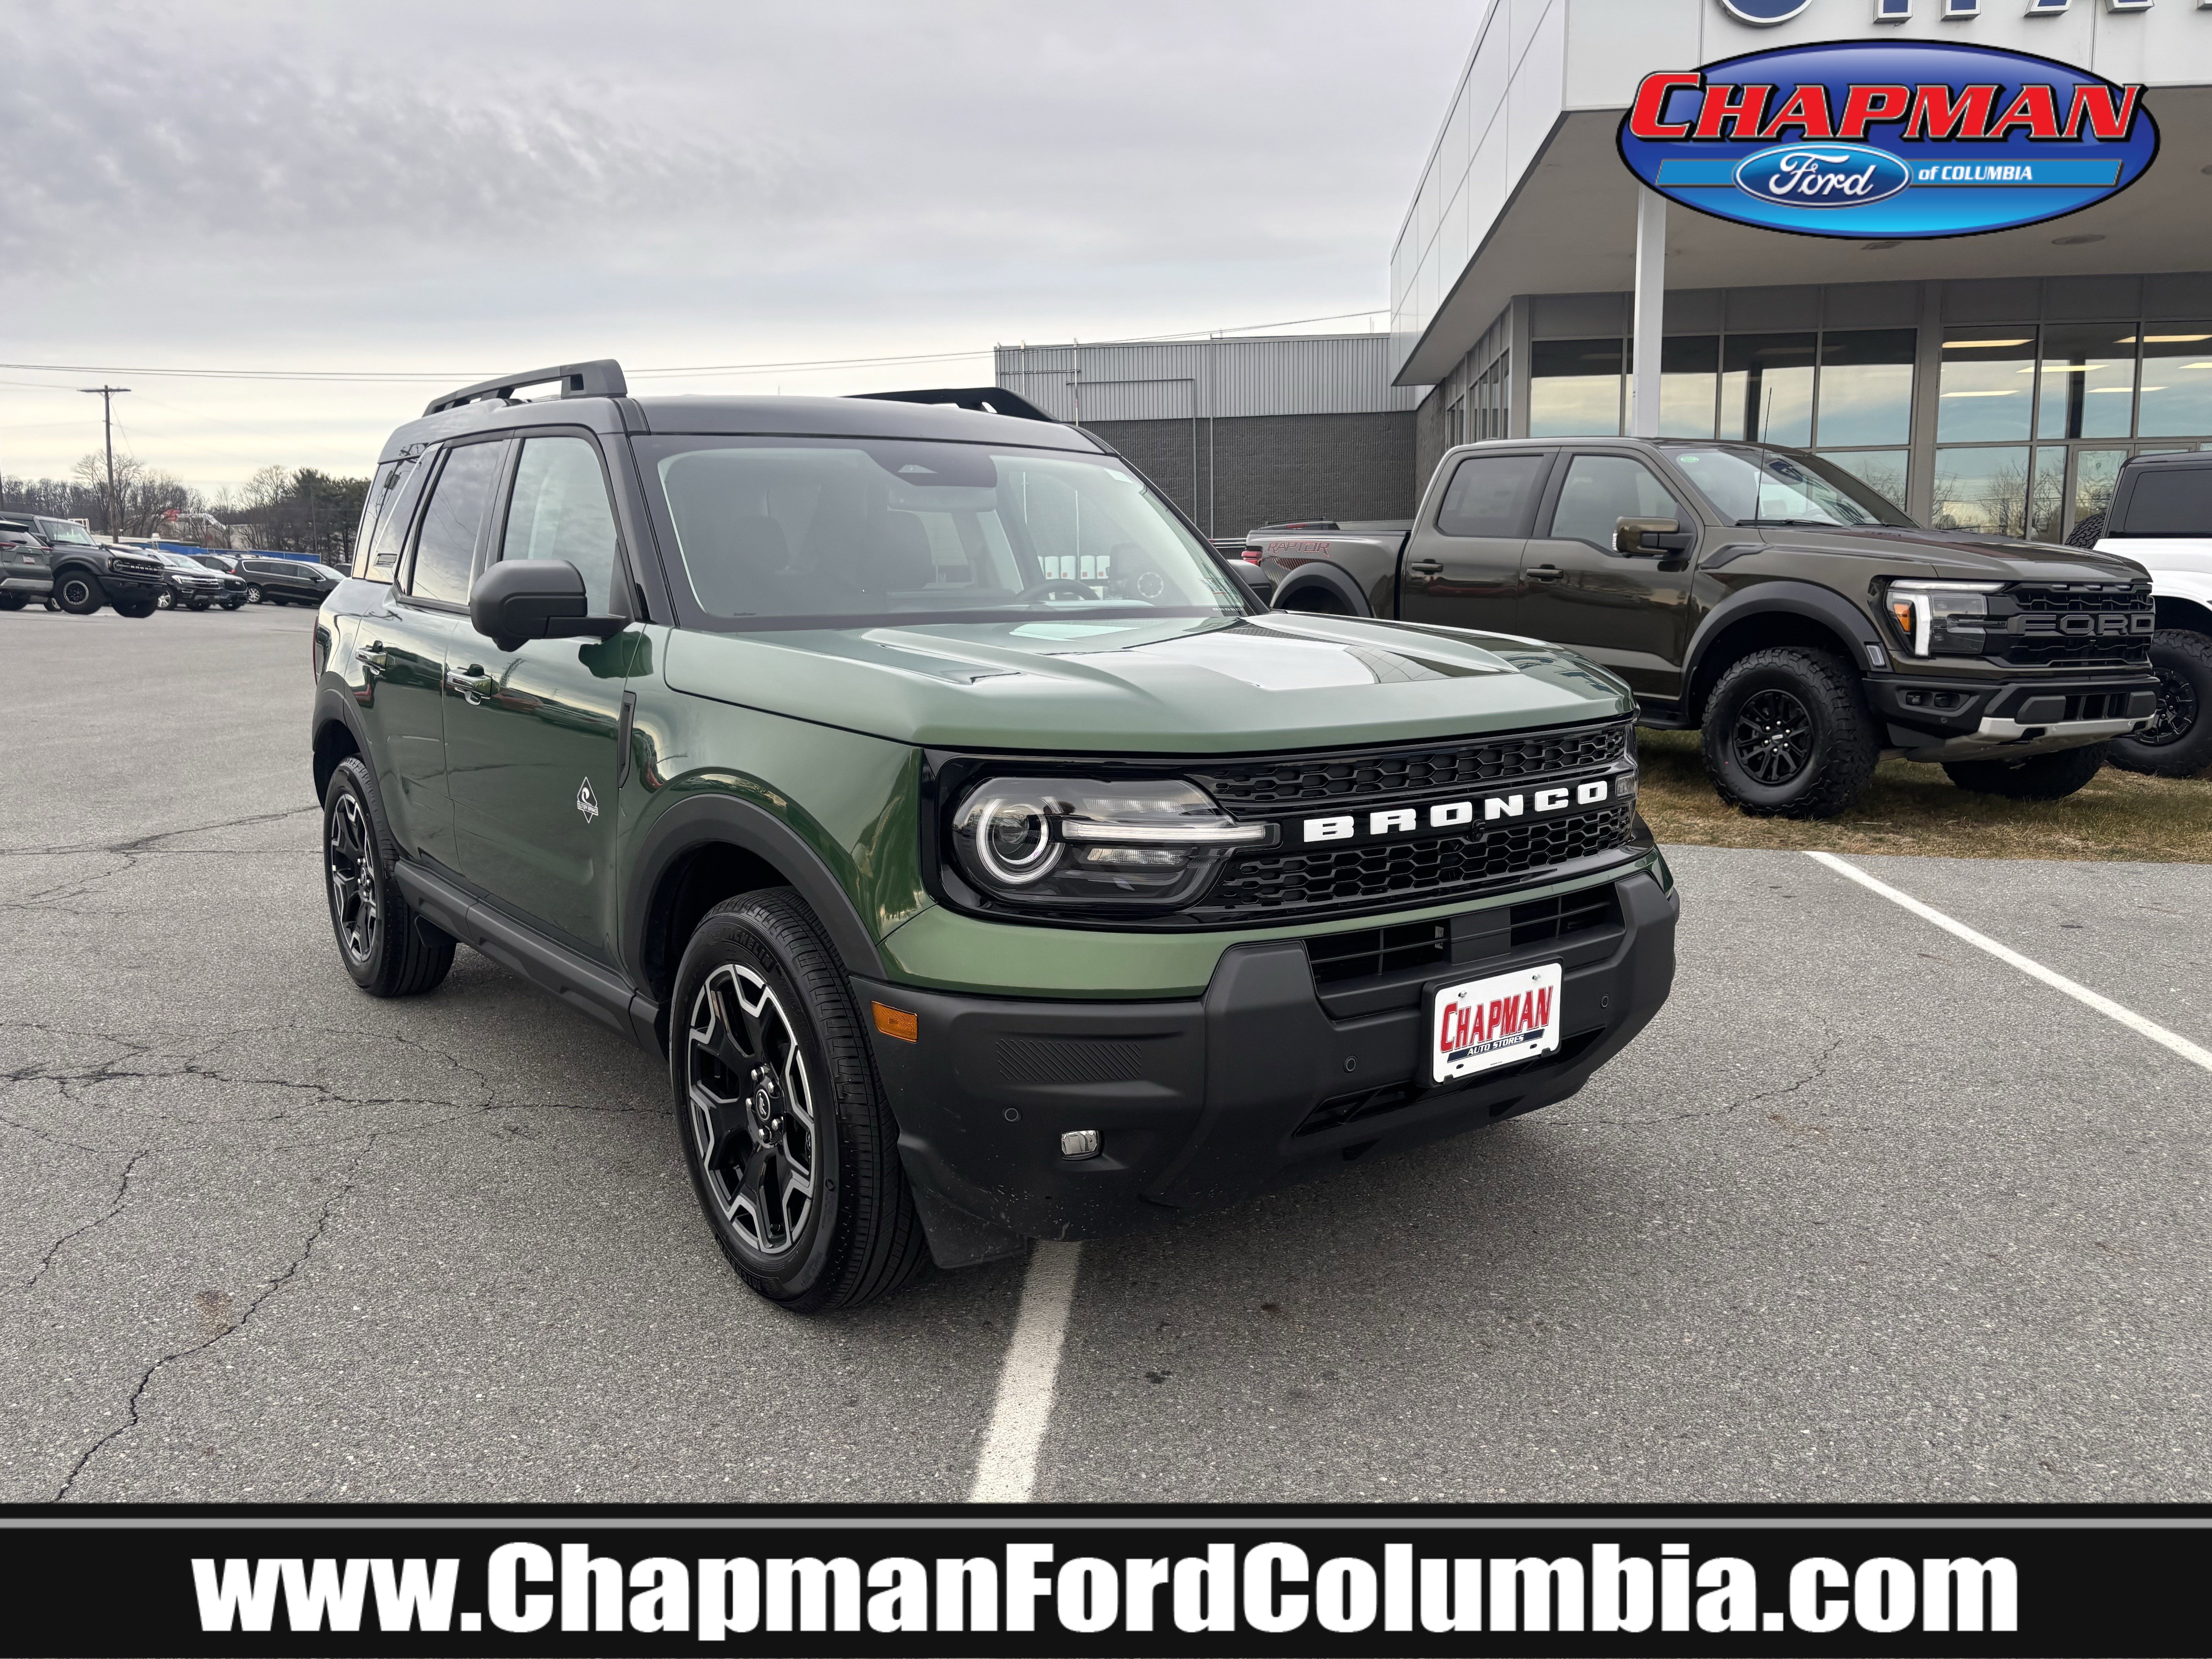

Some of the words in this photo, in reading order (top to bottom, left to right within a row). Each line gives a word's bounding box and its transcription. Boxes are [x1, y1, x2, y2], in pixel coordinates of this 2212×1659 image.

[1266, 541, 1331, 558] RAPTOR
[2006, 614, 2155, 636] FORD
[1303, 780, 1608, 843] BRONCO
[1441, 986, 1553, 1053] CHAPMAN
[1467, 1044, 1491, 1056] AUTO
[1492, 1034, 1524, 1049] STORES
